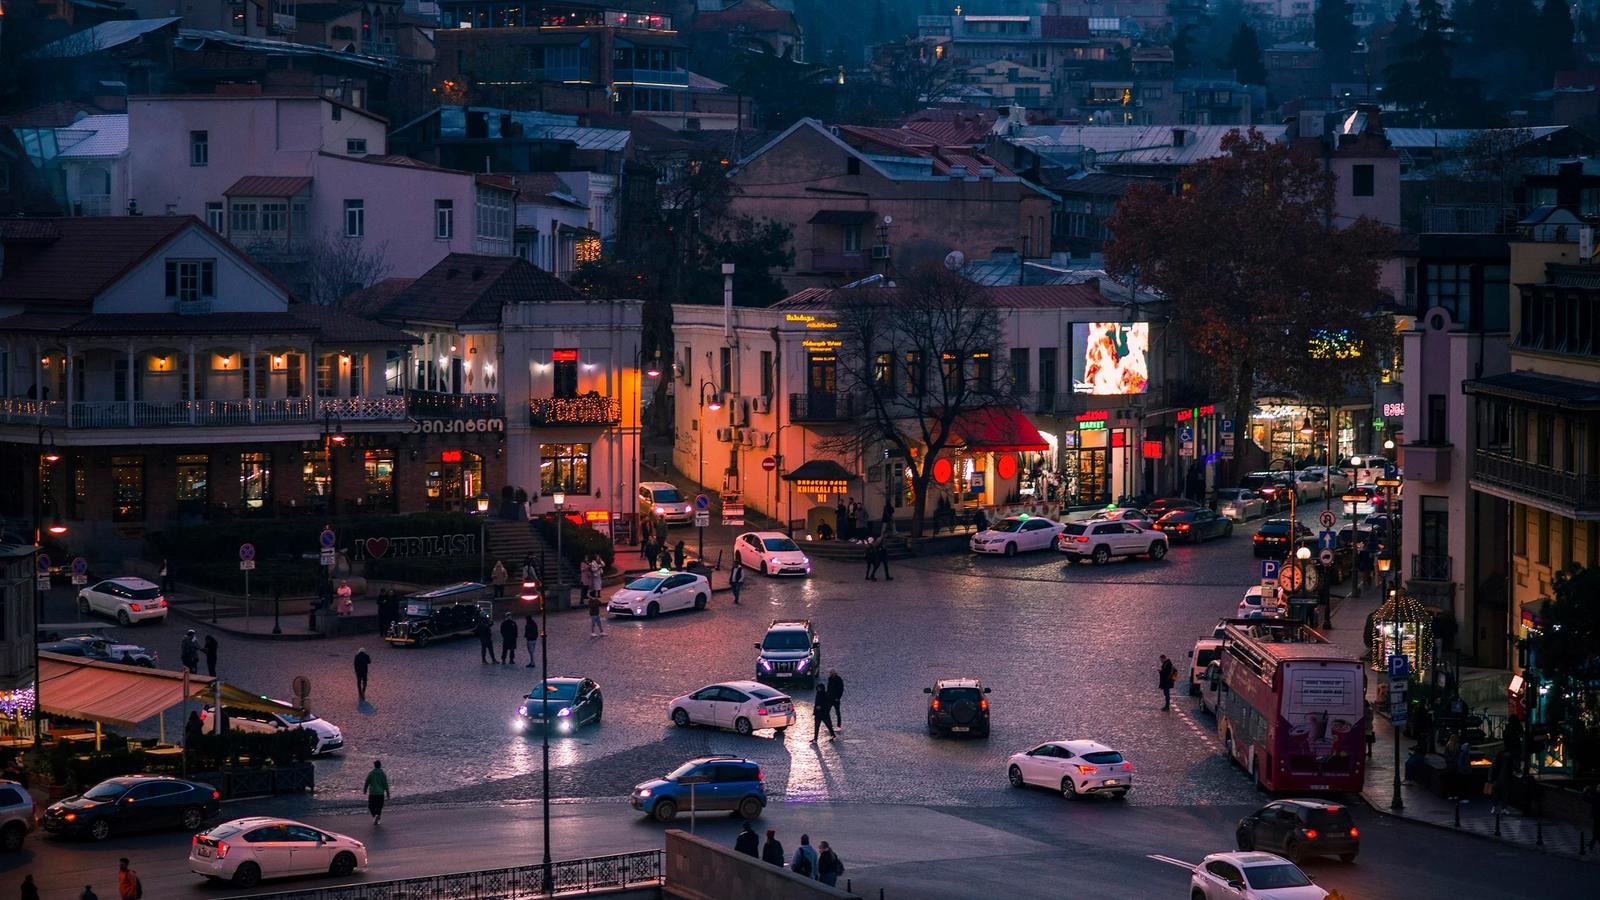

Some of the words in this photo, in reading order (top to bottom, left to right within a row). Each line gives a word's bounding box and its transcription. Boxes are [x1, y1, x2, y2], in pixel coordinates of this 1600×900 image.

[1079, 421, 1105, 430] MARKET
[1223, 420, 1232, 431] P
[390, 534, 476, 560] TBILISI
[1265, 563, 1275, 576] P
[1393, 658, 1403, 674] P
